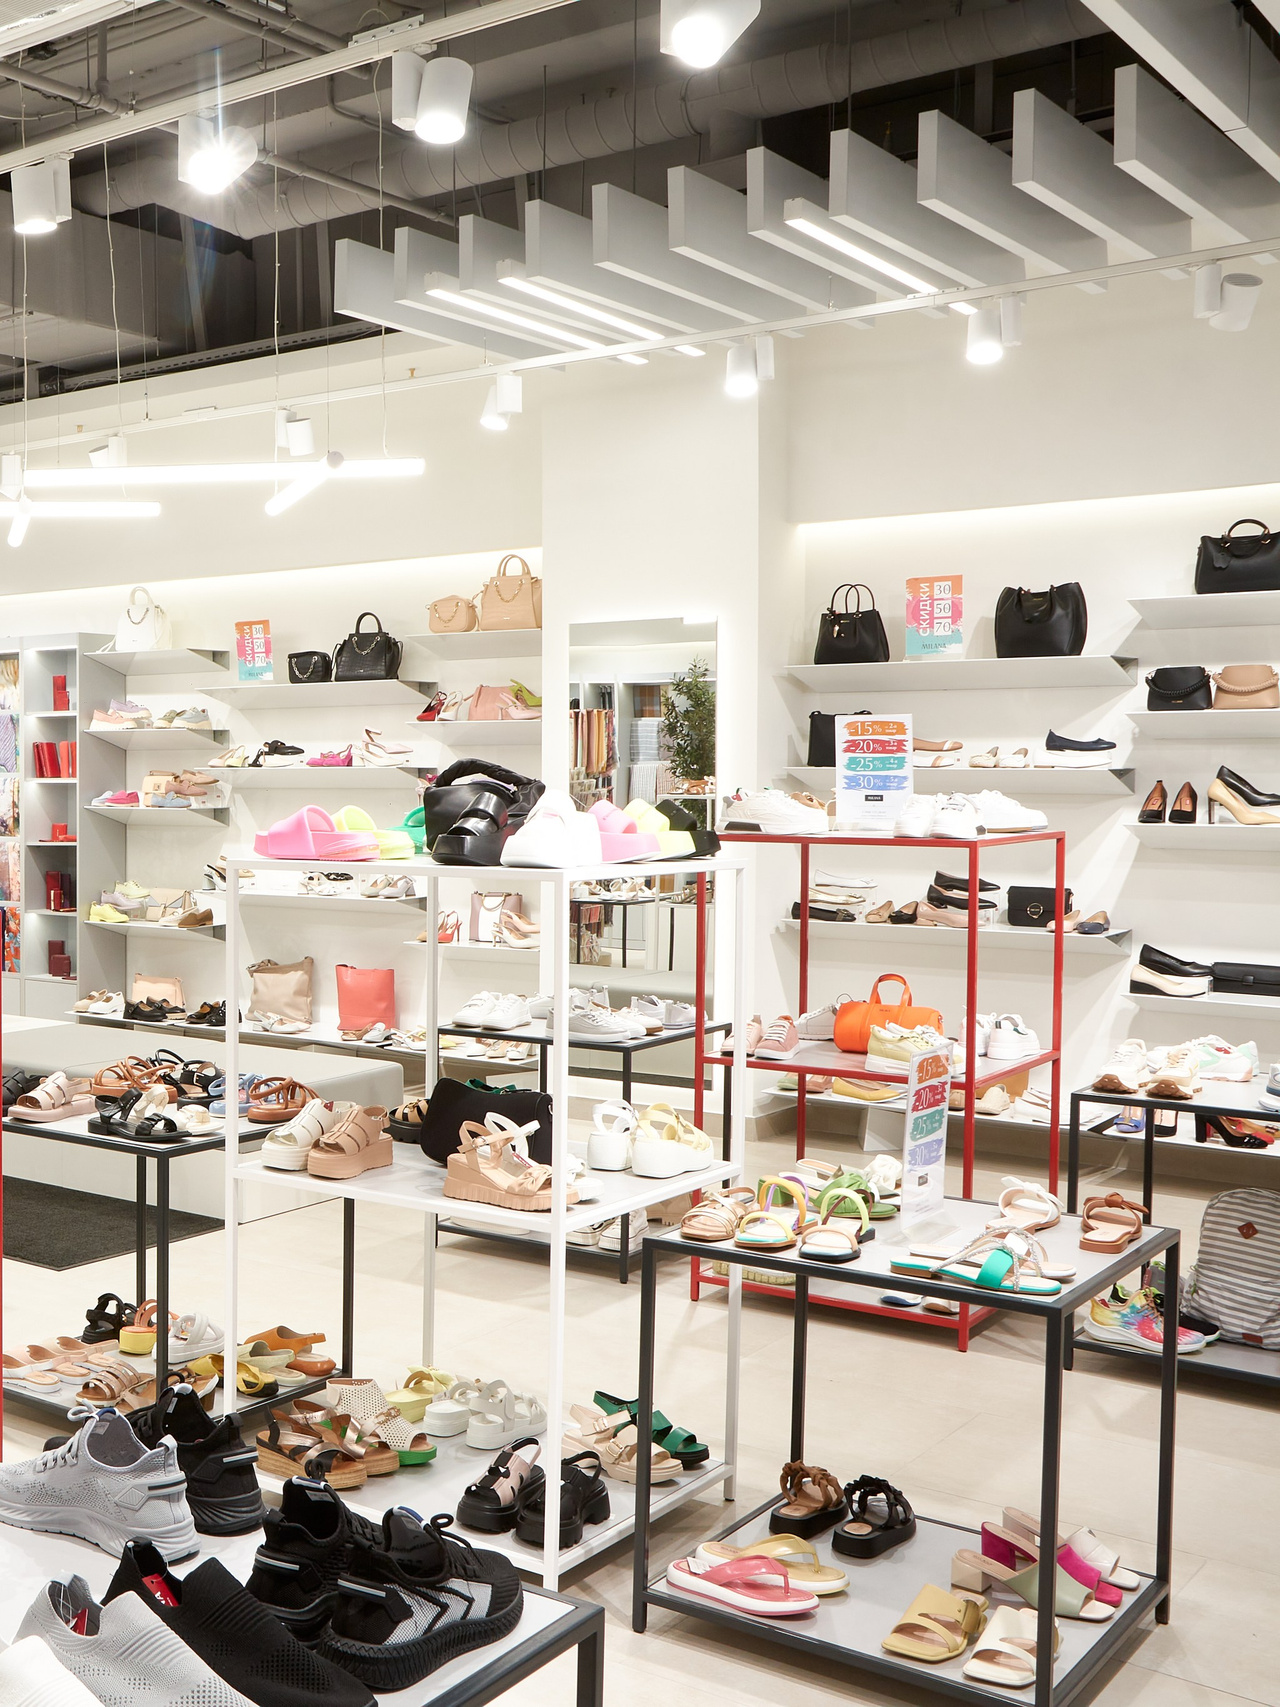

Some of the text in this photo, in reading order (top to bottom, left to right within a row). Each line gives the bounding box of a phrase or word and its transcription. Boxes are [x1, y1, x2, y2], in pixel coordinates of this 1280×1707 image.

[935, 584, 951, 596] 30
[919, 582, 932, 637] СКИДКИ
[935, 603, 951, 614] 50
[935, 621, 951, 633] 70
[850, 722, 882, 735] -15%
[850, 740, 882, 753] -20%
[850, 757, 883, 771] -25%
[850, 776, 883, 789] -30%
